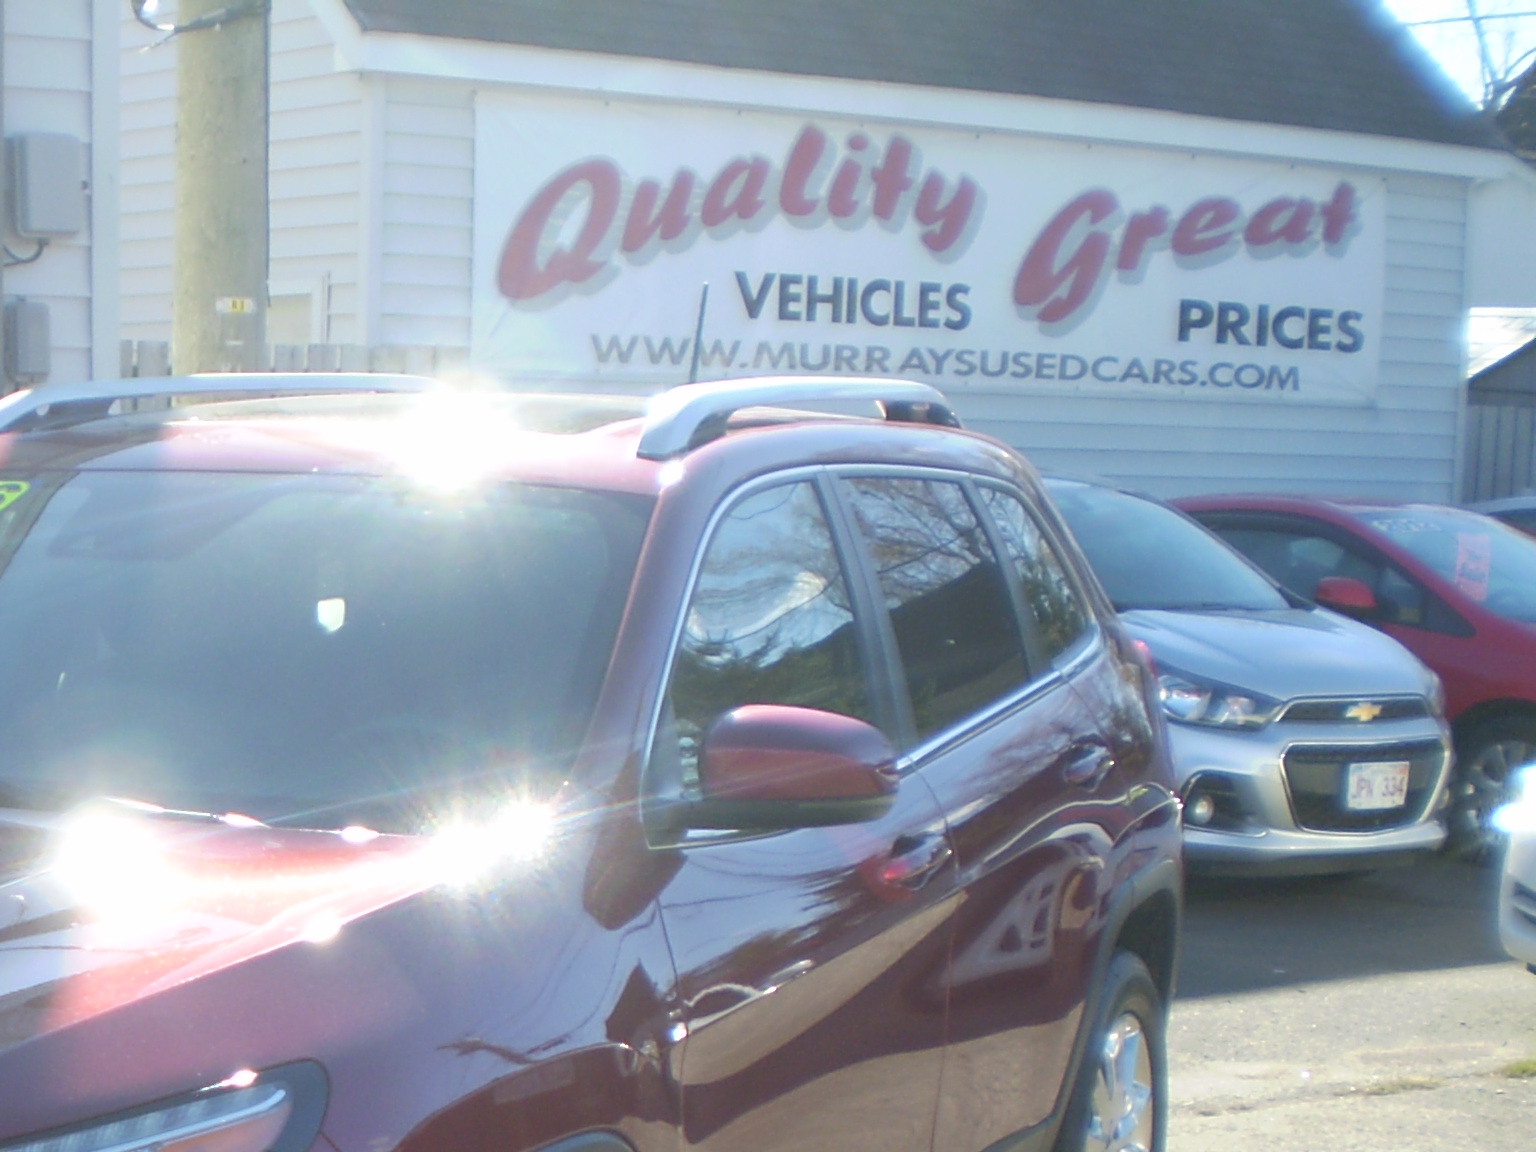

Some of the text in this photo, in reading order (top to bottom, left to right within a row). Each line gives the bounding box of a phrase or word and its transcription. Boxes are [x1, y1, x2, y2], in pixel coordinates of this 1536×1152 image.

[497, 123, 1359, 326] Quality Great
[734, 269, 973, 332] VEHICLES
[1176, 298, 1365, 353] PRICES
[590, 331, 1301, 392] WWW.MURRAYSUSEDCARS.COM
